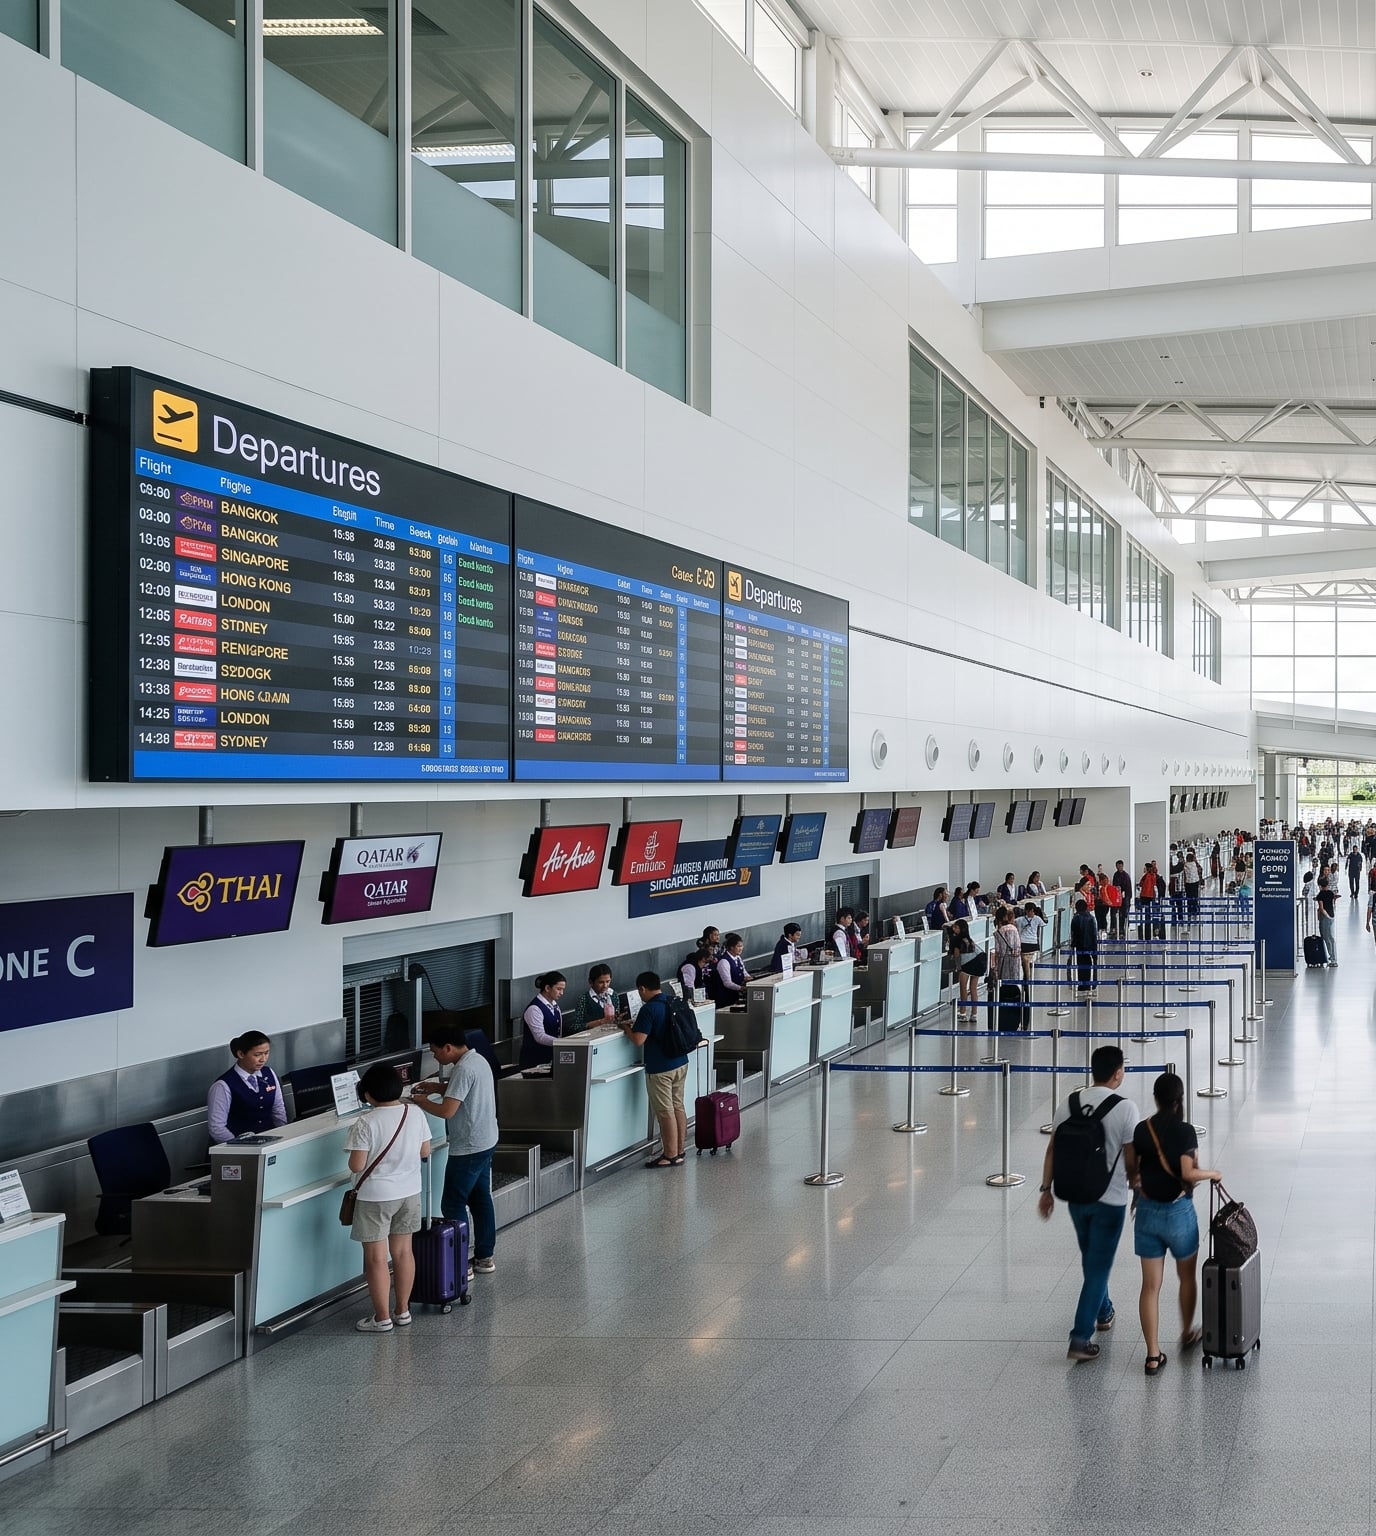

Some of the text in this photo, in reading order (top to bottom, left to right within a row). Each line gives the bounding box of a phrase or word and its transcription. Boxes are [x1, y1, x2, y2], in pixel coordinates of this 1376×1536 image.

[139, 456, 172, 475] Flight
[213, 414, 382, 496] Departures
[221, 501, 279, 525] BANGKOK
[221, 525, 279, 548] BANGKOK
[221, 548, 290, 572] SINGAPORE
[221, 571, 257, 588] HONG
[259, 576, 292, 594] KONG
[221, 594, 271, 613] LONDON
[745, 579, 803, 615] Departures
[221, 687, 255, 702] HONG
[139, 706, 171, 720] 14:25
[220, 711, 270, 726] LONDON
[220, 734, 269, 748] SYDNEY
[356, 847, 405, 868] QATAR
[216, 873, 283, 904] THAI
[363, 879, 409, 900] QATAR
[0, 934, 95, 982] NE C
